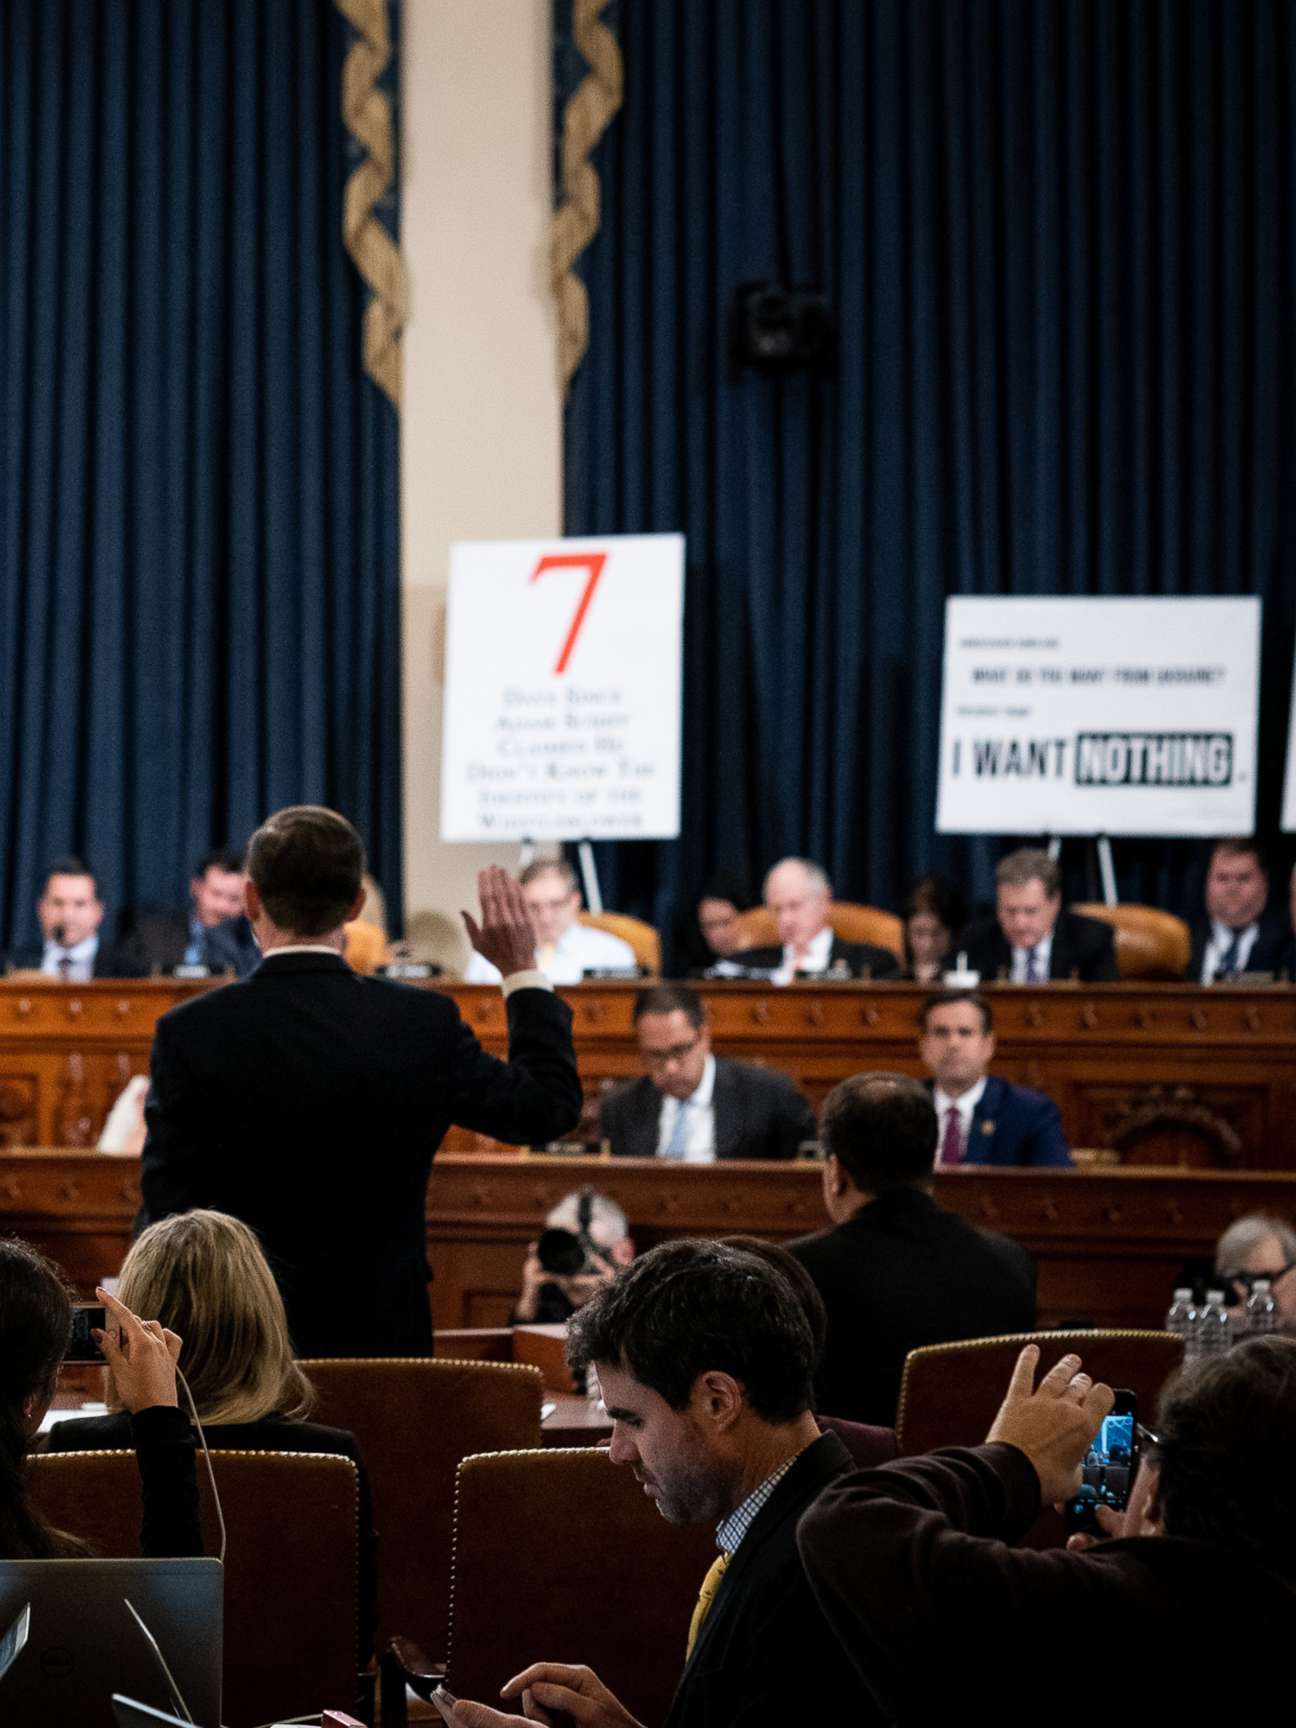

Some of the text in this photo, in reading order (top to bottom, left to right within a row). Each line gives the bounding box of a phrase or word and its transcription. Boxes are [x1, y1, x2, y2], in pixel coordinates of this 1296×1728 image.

[528, 552, 608, 676] 7
[953, 739, 962, 777] I
[972, 738, 1068, 778] WANT
